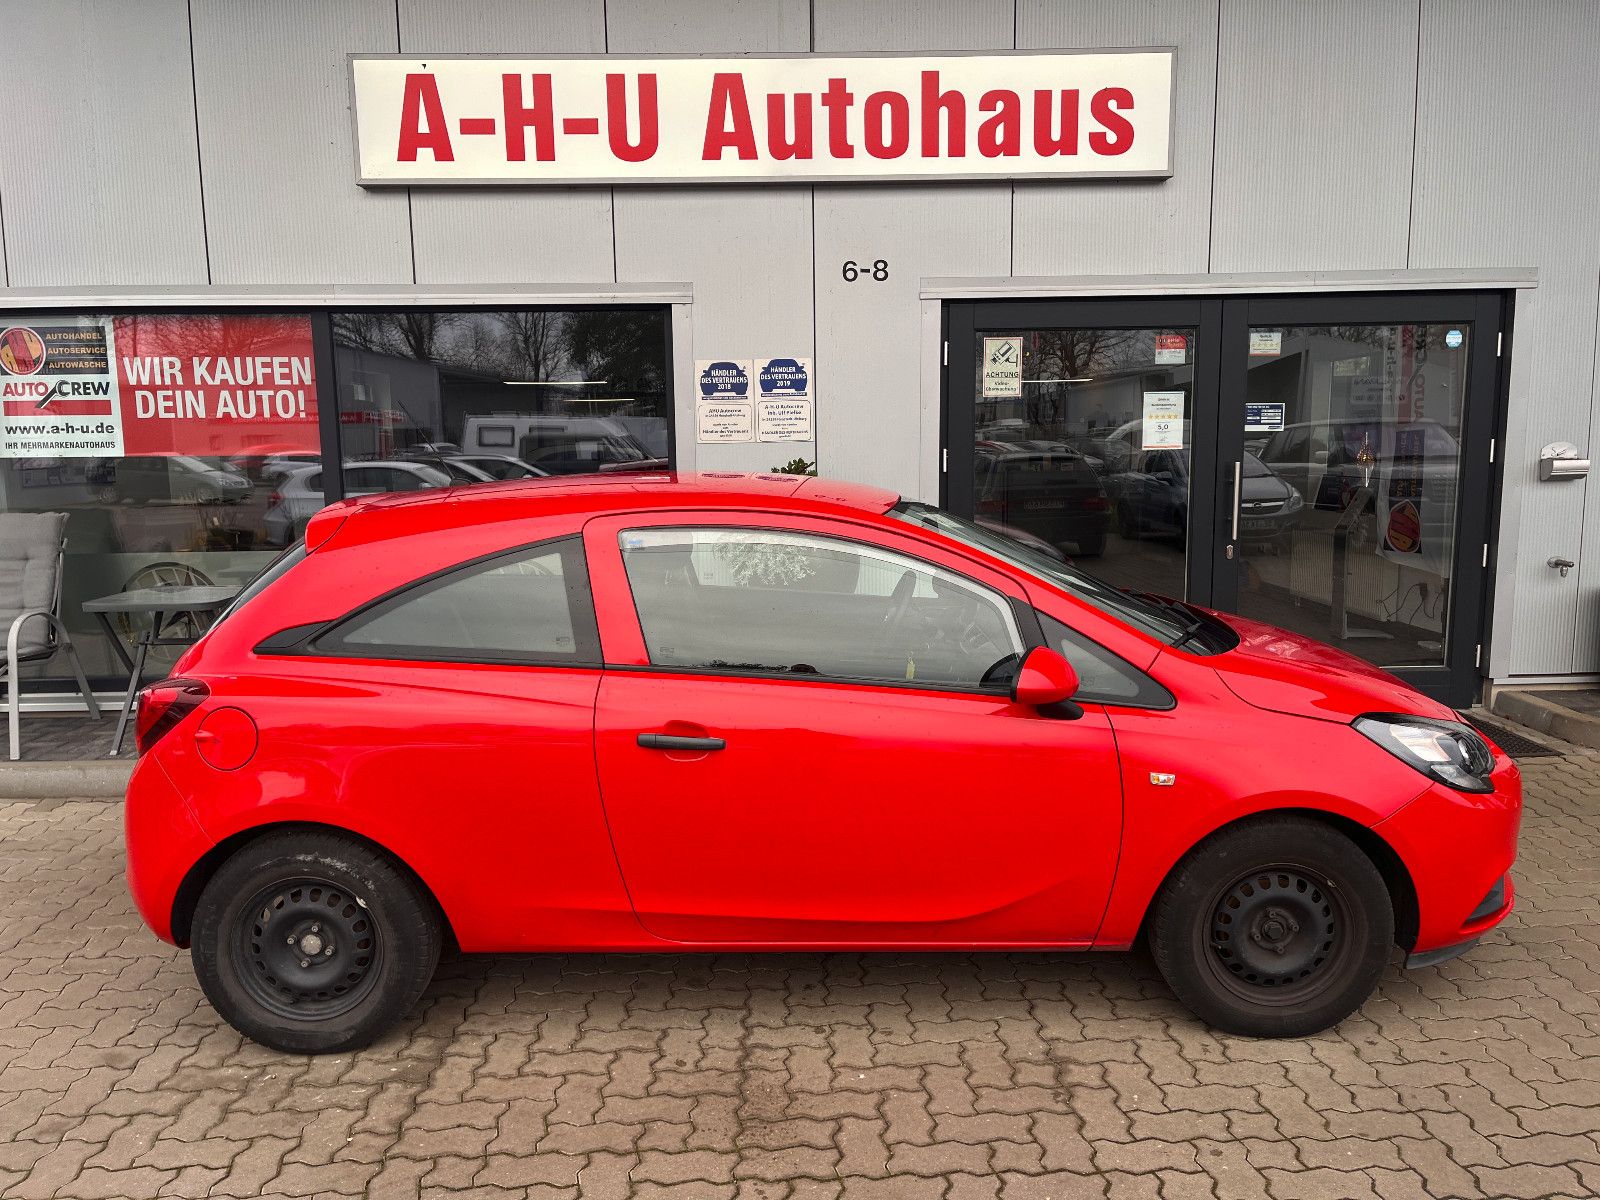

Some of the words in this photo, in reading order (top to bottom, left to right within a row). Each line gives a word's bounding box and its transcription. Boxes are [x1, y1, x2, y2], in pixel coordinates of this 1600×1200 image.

[397, 73, 658, 162] A-H-U
[702, 70, 1135, 161] Autohaus
[842, 259, 889, 283] 6-8
[45, 332, 102, 340] AUTOHANDEL
[47, 346, 106, 354] AUTOSERVICE
[49, 360, 107, 369] AUTOWÄSCHE
[123, 357, 183, 386] WIR
[194, 356, 312, 386] KAUFEN
[985, 371, 1019, 379] ACHTUNG
[3, 382, 49, 397] AUTO
[57, 380, 110, 396] CREW
[135, 390, 207, 419] DEIN
[216, 390, 306, 418] AUTO!
[5, 422, 115, 434] www.a-h-u.de
[5, 442, 19, 450] IHR
[20, 440, 116, 450] MEHRMARKENAUTOHAUS
